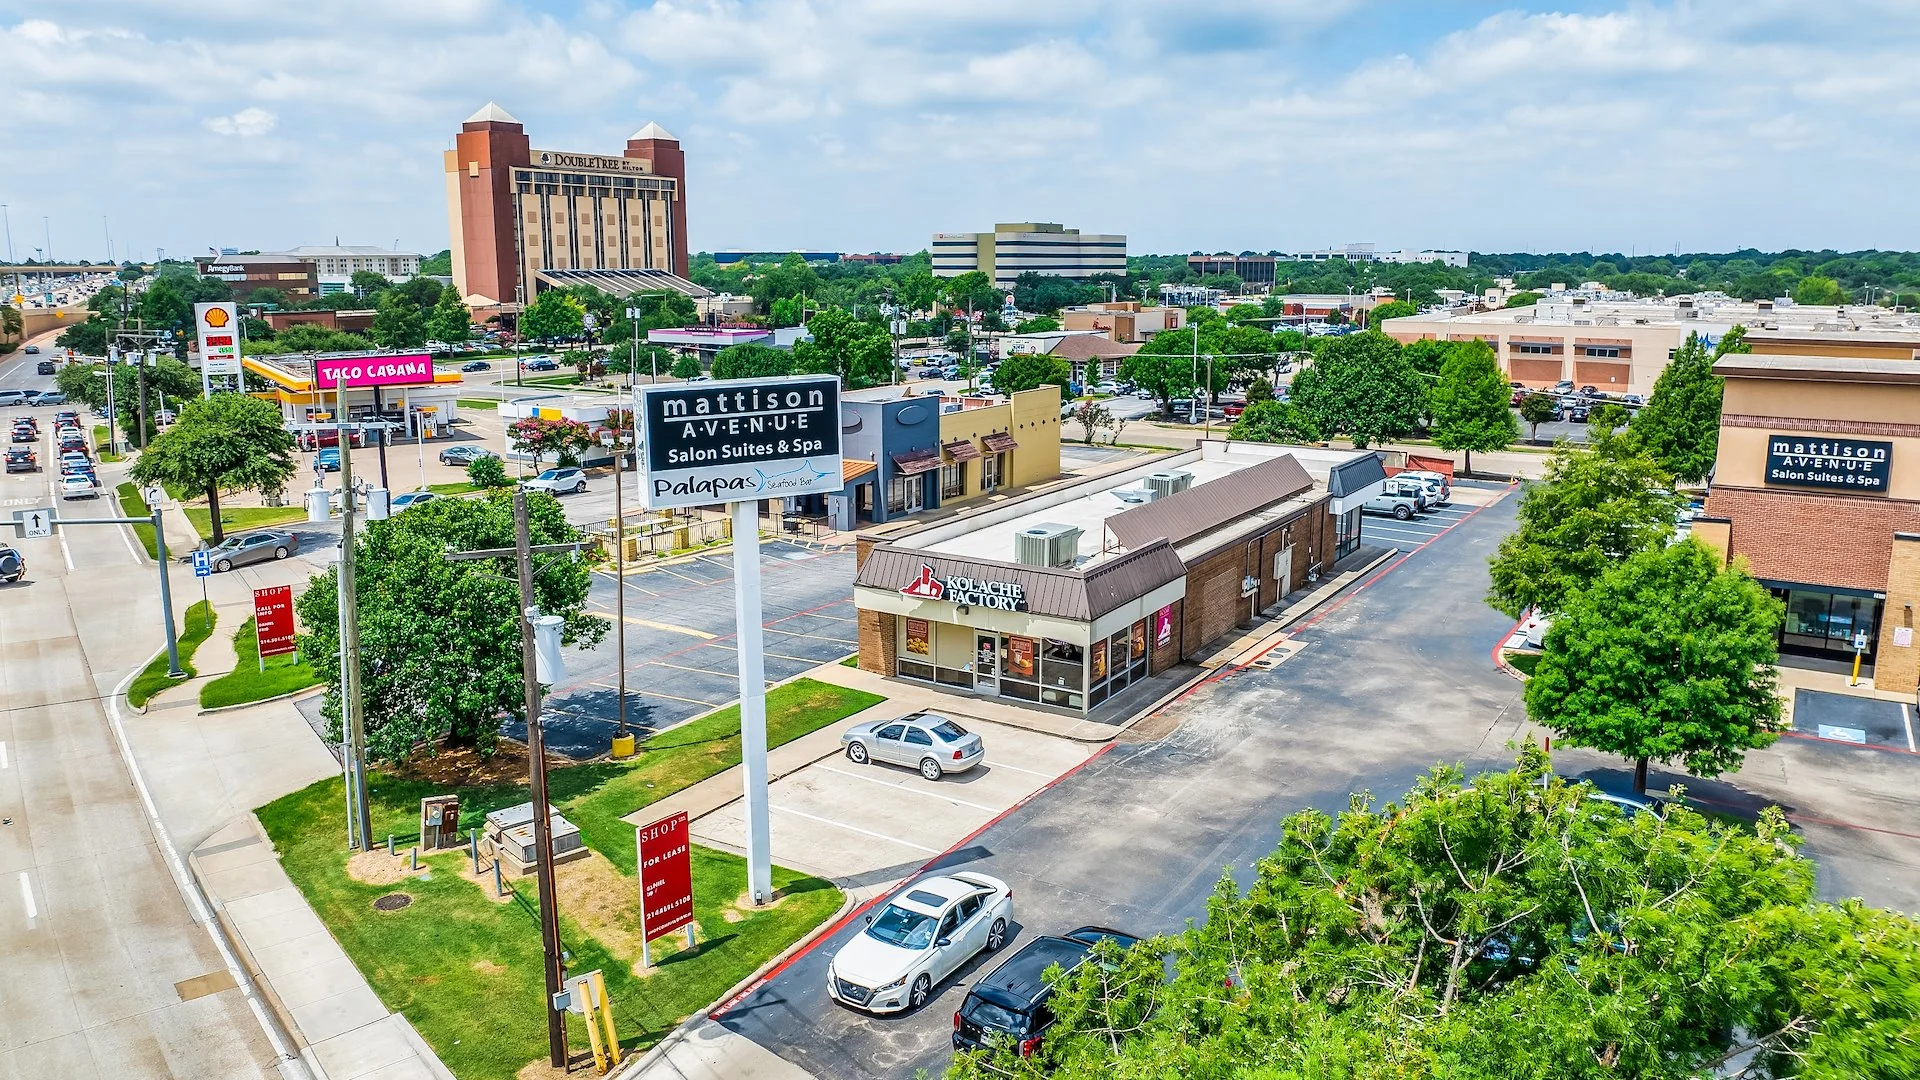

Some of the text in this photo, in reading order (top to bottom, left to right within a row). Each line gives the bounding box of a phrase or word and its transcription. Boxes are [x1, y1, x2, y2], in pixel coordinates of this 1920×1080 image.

[207, 264, 245, 273] AmegyBank
[322, 361, 427, 380] TACO CABANA
[663, 388, 823, 416] mattison
[668, 438, 822, 464] Salon Suites & Spa
[1773, 441, 1885, 459] mattison
[653, 475, 757, 498] Palapas
[767, 477, 813, 490] Seafood Bar
[1771, 469, 1880, 487] Salon Suites & Spa
[29, 528, 47, 536] ONLY
[193, 552, 210, 567] H
[254, 587, 283, 598] SHOP
[946, 575, 1022, 598] KOLACHE
[948, 589, 1020, 611] FACTORY
[641, 819, 678, 843] SHOP
[643, 844, 686, 869] FOR LEASE
